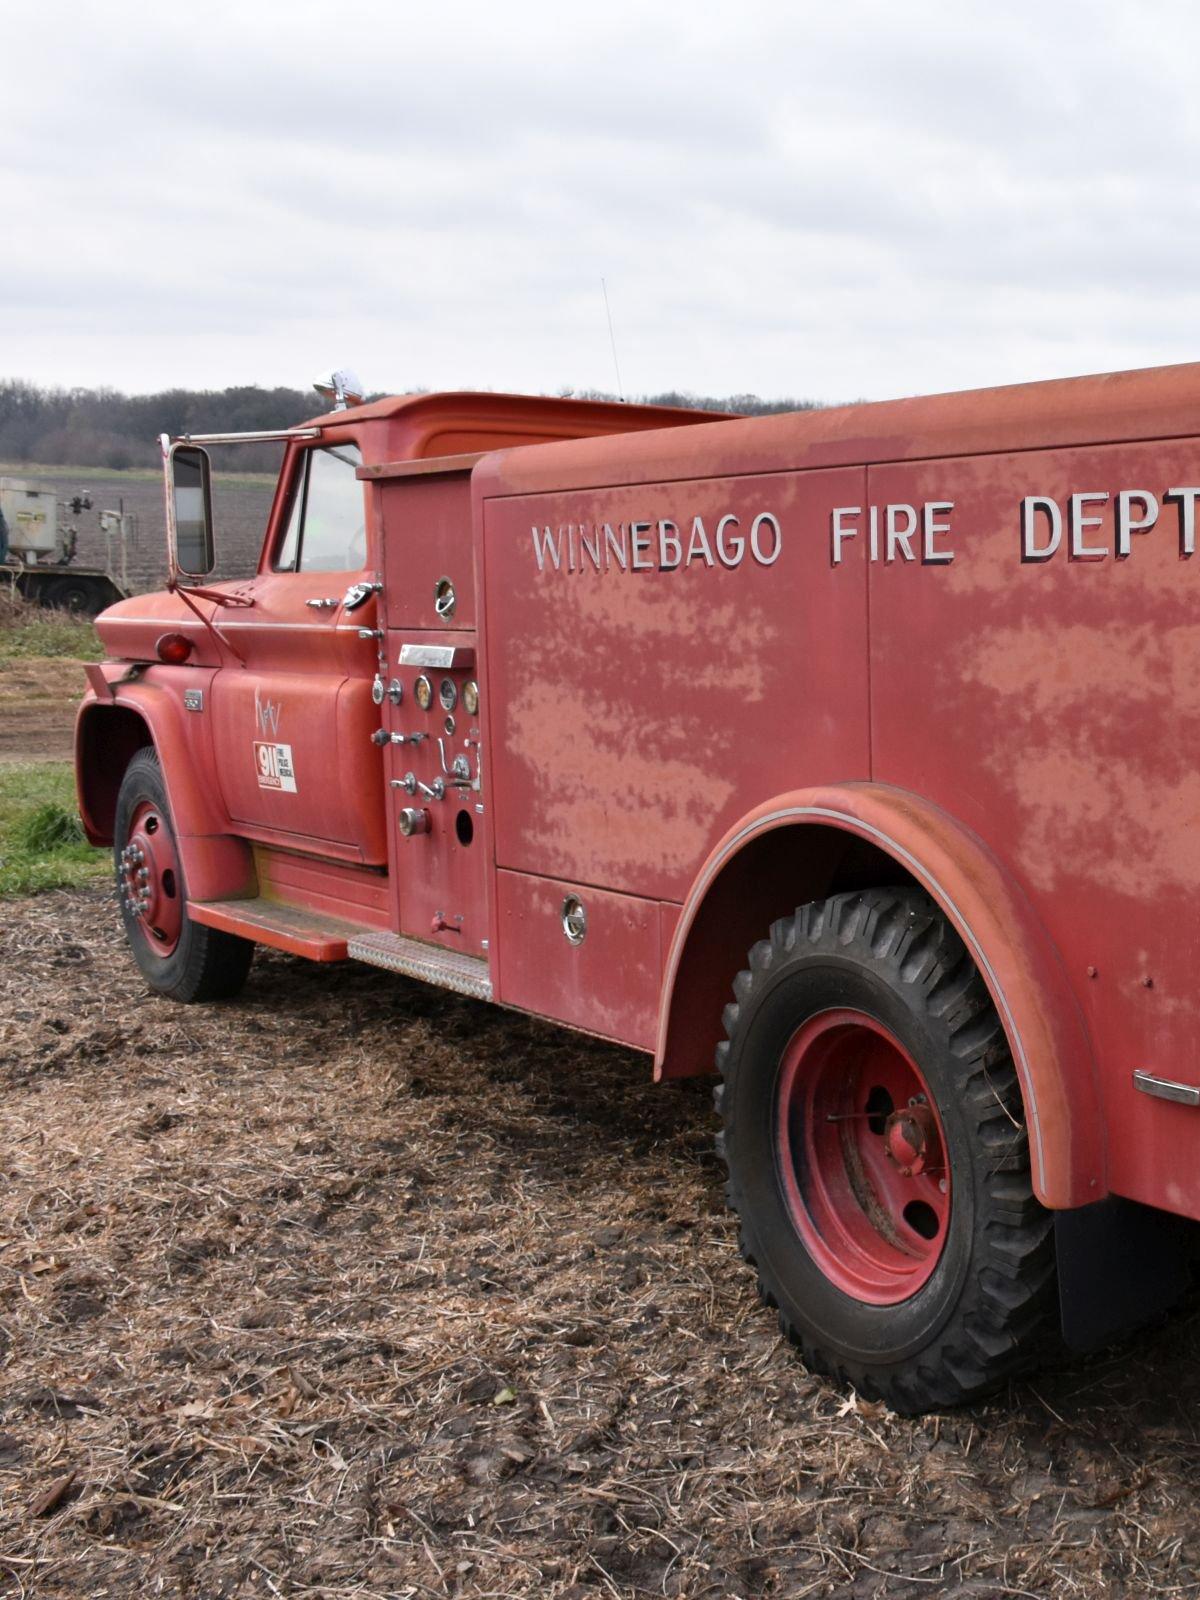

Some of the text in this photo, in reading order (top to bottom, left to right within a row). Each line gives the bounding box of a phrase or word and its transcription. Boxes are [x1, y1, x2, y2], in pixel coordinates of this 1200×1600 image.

[531, 511, 783, 572] WINNEBAGO
[831, 501, 955, 566] FIRE
[259, 744, 280, 779] 911
